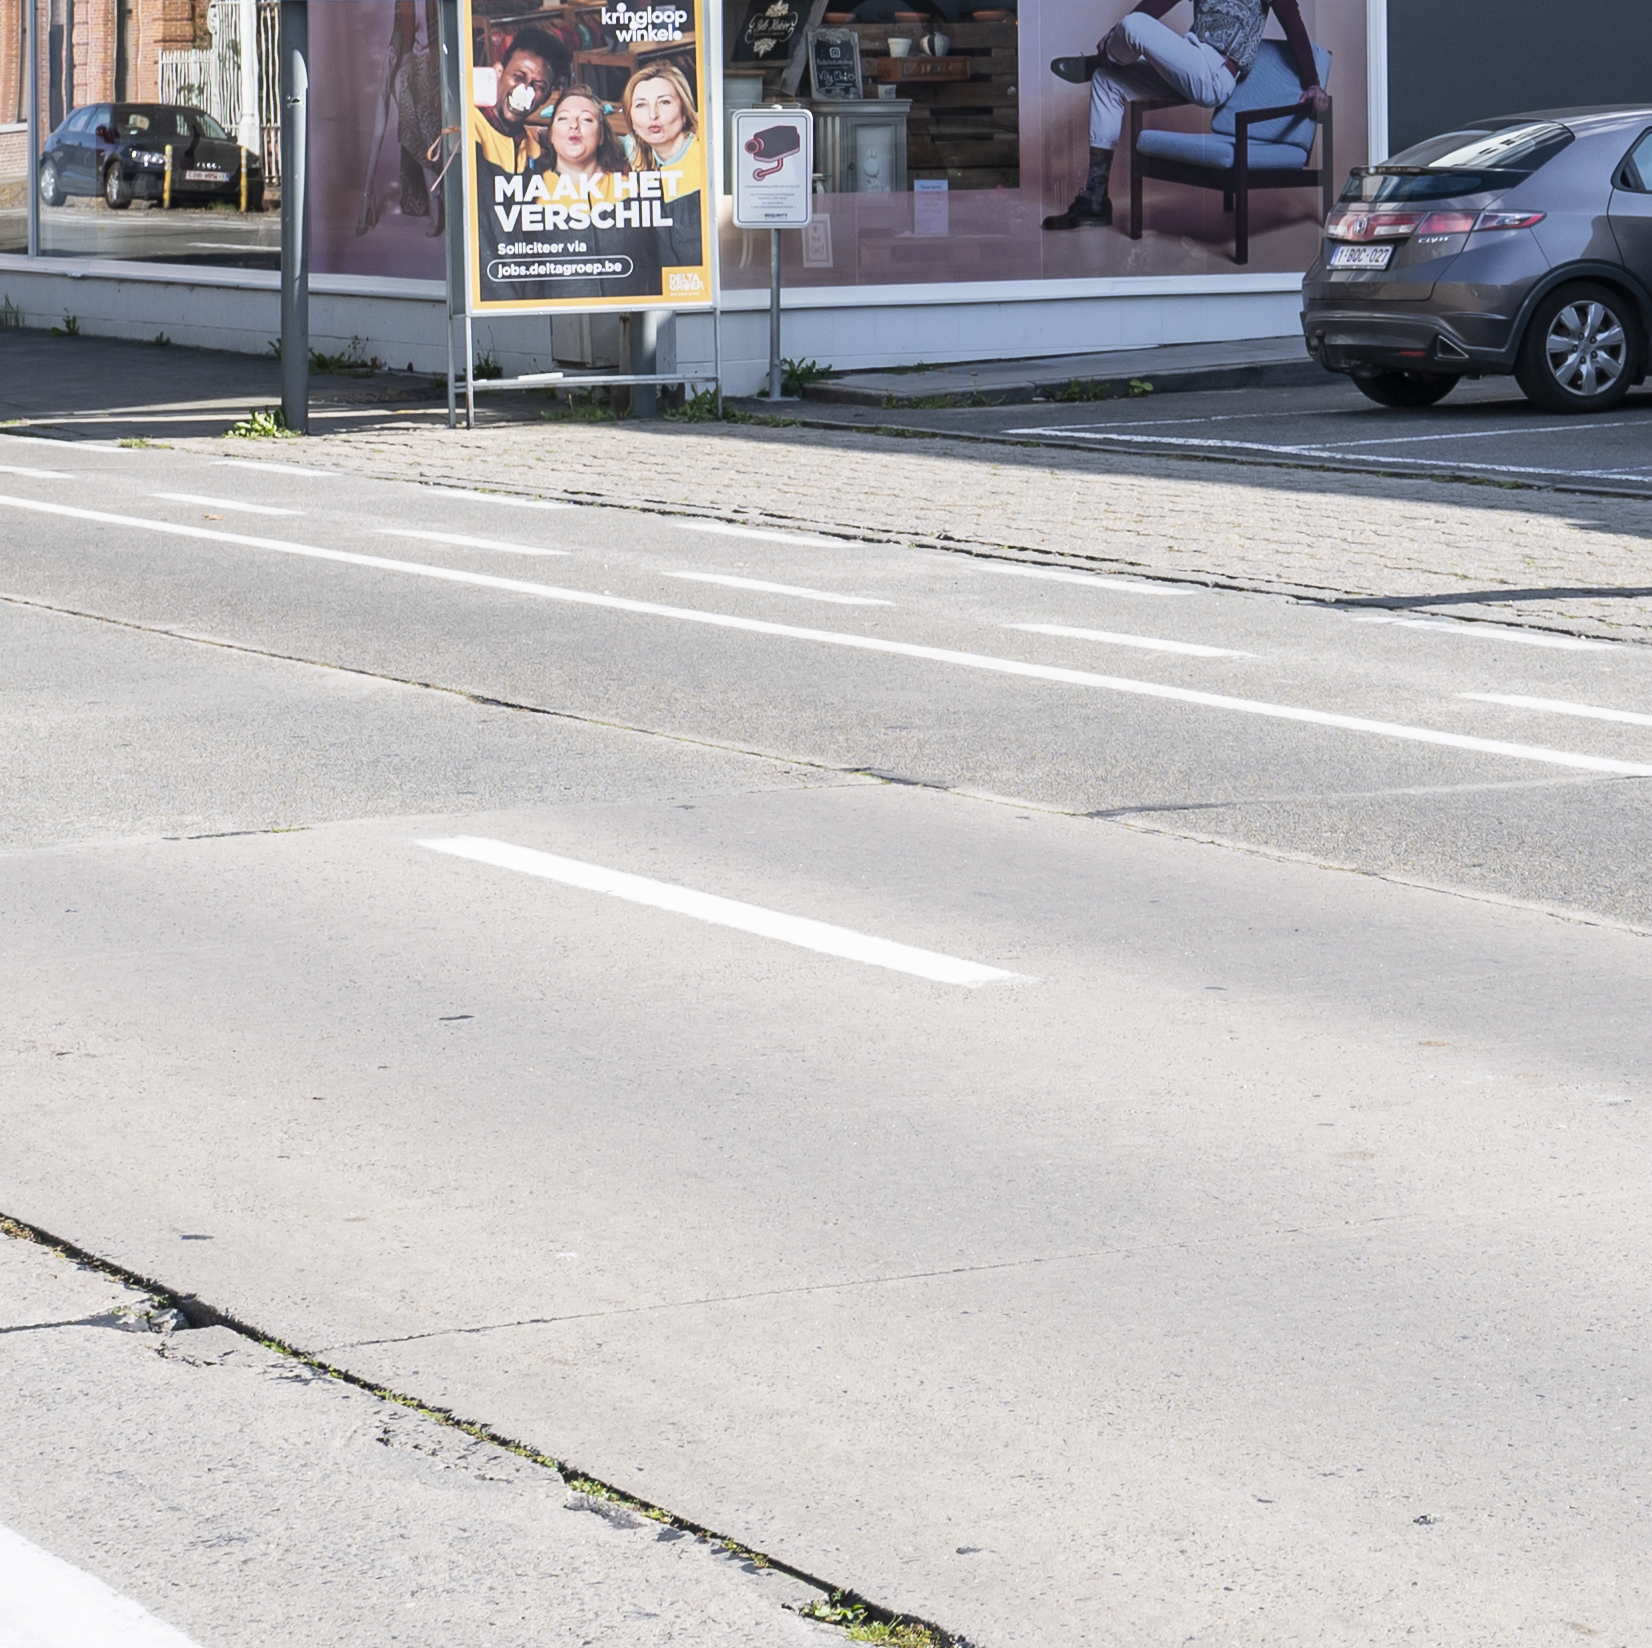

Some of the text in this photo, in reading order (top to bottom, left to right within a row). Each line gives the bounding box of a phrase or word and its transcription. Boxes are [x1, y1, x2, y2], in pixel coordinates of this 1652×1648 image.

[601, 3, 688, 28] kringloop
[494, 169, 683, 203] MAAK HET
[494, 199, 673, 232] VERSCHIL
[498, 240, 587, 255] Solliciteer via
[498, 261, 622, 278] jobs.deltagroep.be
[669, 273, 699, 282] DELTA
